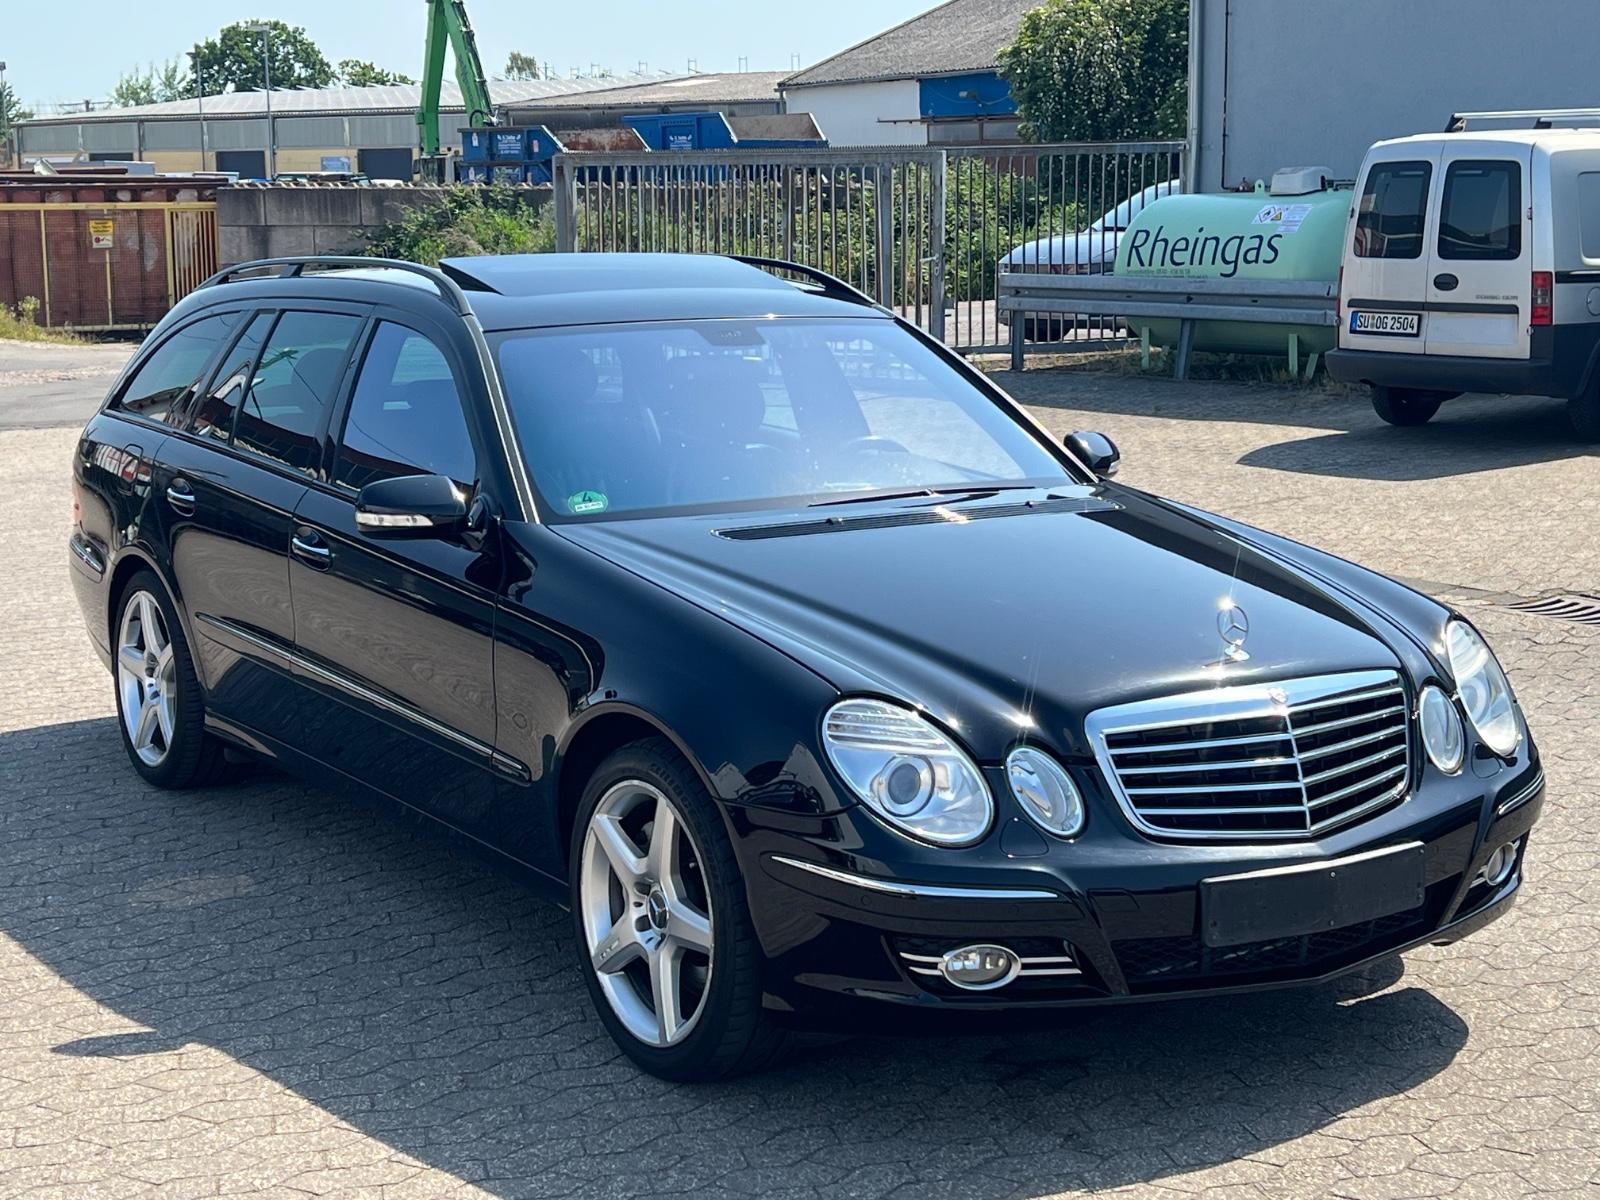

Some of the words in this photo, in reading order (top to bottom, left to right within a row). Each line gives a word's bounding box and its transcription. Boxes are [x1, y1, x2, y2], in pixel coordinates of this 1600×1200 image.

[1126, 225, 1283, 278] Rheingas
[1357, 315, 1370, 328] SU
[1375, 315, 1388, 329] OG
[1390, 316, 1414, 331] 2504
[582, 492, 592, 503] 4
